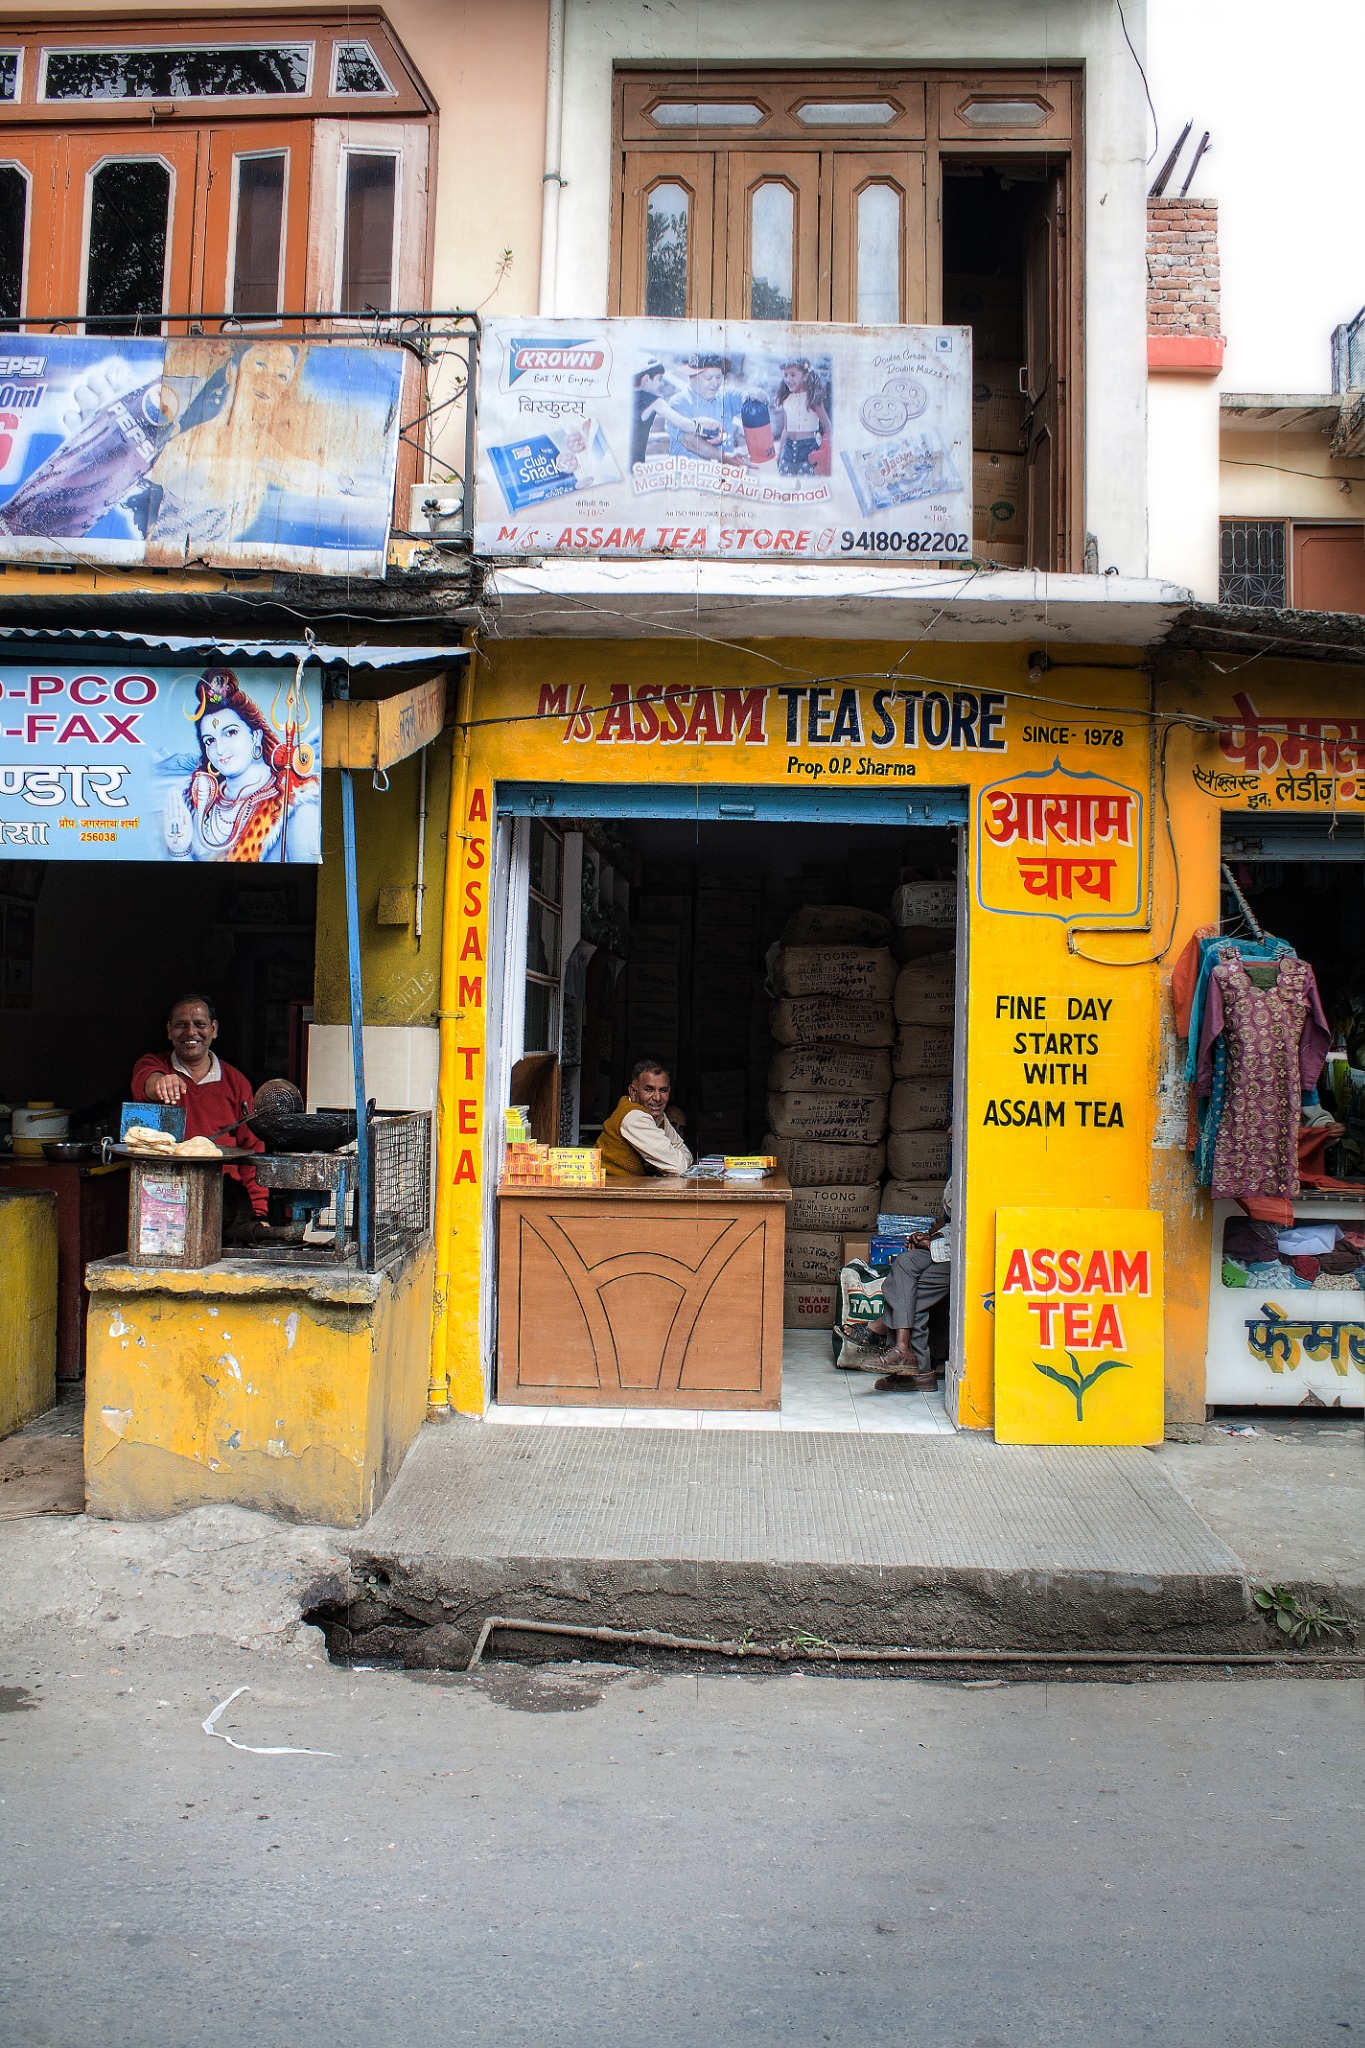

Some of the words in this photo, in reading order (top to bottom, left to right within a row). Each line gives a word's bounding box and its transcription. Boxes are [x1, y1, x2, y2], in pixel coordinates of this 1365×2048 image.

[520, 351, 595, 368] KROWN
[533, 374, 548, 383] Eat
[107, 401, 157, 464] PEPSI
[520, 459, 569, 483] Snacks
[524, 455, 547, 469] Club
[635, 459, 675, 477] Swad
[679, 459, 756, 483] Bemisaal...
[635, 474, 677, 492] Masti,
[735, 482, 758, 497] Aur
[762, 486, 829, 503] Dhamaal
[929, 505, 947, 513] 150g
[556, 527, 646, 549] ASSAM
[656, 527, 707, 549] TEA
[717, 529, 812, 550] STORE
[841, 530, 969, 553] 94180-82202
[595, 683, 770, 746] ASSAM
[778, 687, 865, 747] TEA
[870, 688, 1007, 753] STORE
[1084, 729, 1124, 746] 1978
[856, 757, 916, 776] Sharma
[985, 791, 1136, 847] आसाम
[80, 832, 117, 842] 256038
[1016, 857, 1118, 902] चाय
[459, 788, 488, 1008] ASSAM
[816, 952, 858, 961] TOONG
[995, 996, 1046, 1020] FINE
[1067, 998, 1113, 1021] DAY
[1013, 1032, 1099, 1055] STARTS
[1023, 1063, 1087, 1086] WITH
[453, 1047, 480, 1186] TEA
[983, 1100, 1066, 1127] ASSAM
[1074, 1101, 1124, 1128] TEA
[794, 1202, 818, 1211] DALMIA
[820, 1204, 833, 1212] TEA
[834, 1204, 870, 1213] PLANTATION
[813, 1191, 856, 1201] TOONG
[799, 1211, 835, 1219] INDUSTRIES
[1001, 1248, 1152, 1298] ASSAM
[798, 1304, 829, 1314] 2009
[850, 1298, 884, 1315] TAT
[1028, 1302, 1128, 1351] TEA
